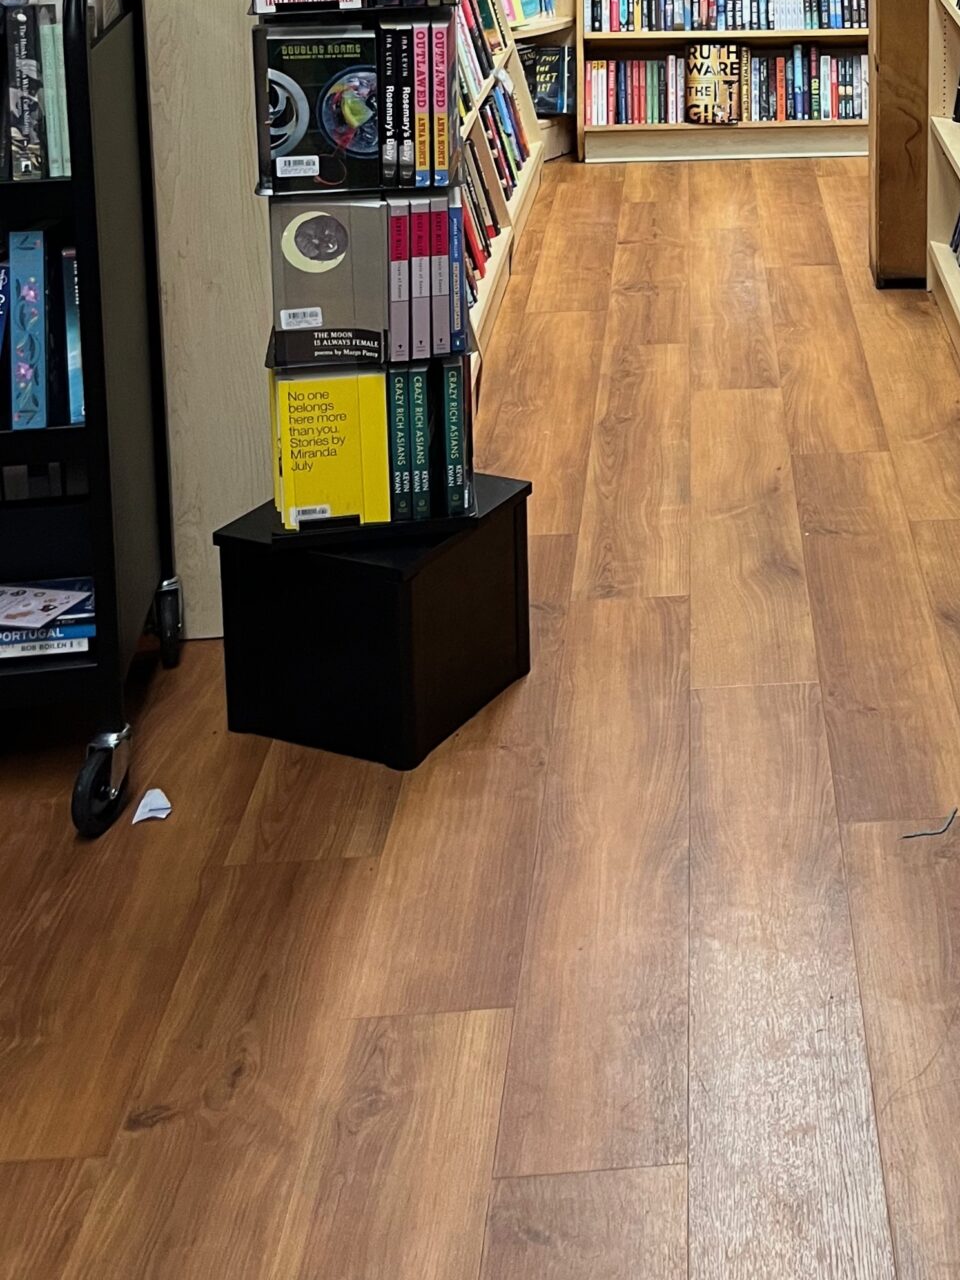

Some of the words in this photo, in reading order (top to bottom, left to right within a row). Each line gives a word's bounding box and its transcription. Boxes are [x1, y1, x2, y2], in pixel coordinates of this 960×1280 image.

[281, 45, 325, 55] DOUGLAS
[327, 44, 361, 54] ADAMS
[689, 45, 739, 60] RUTH
[416, 31, 426, 108] OUTLAWED
[435, 31, 445, 108] OUTLAWED
[687, 62, 740, 76] WARE
[687, 85, 711, 97] THE
[386, 85, 395, 137] Rosemary's
[402, 87, 411, 138] Rosemary's
[418, 116, 426, 137] ANNA
[437, 116, 445, 137] ANNA
[386, 139, 395, 162] Baby
[402, 140, 411, 162] Baby
[418, 139, 427, 166] NORTH
[331, 331, 353, 339] MOON
[352, 339, 379, 348] FEMALE
[288, 392, 304, 401] No
[307, 391, 329, 400] one
[395, 377, 403, 411] CRAZY
[414, 376, 423, 410] CRAZY
[288, 402, 334, 415] belongs
[289, 414, 314, 424] here
[316, 412, 347, 422] more
[396, 412, 404, 430] RICH
[415, 411, 423, 429] RICH
[289, 426, 315, 436] than
[316, 425, 340, 438] you.
[289, 437, 329, 448] Stories
[331, 435, 346, 447] by
[397, 431, 406, 465] ASIANS
[416, 430, 425, 464] ASIANS
[290, 448, 337, 459] Miranda
[290, 461, 314, 473] July
[20, 643, 36, 652] BOB
